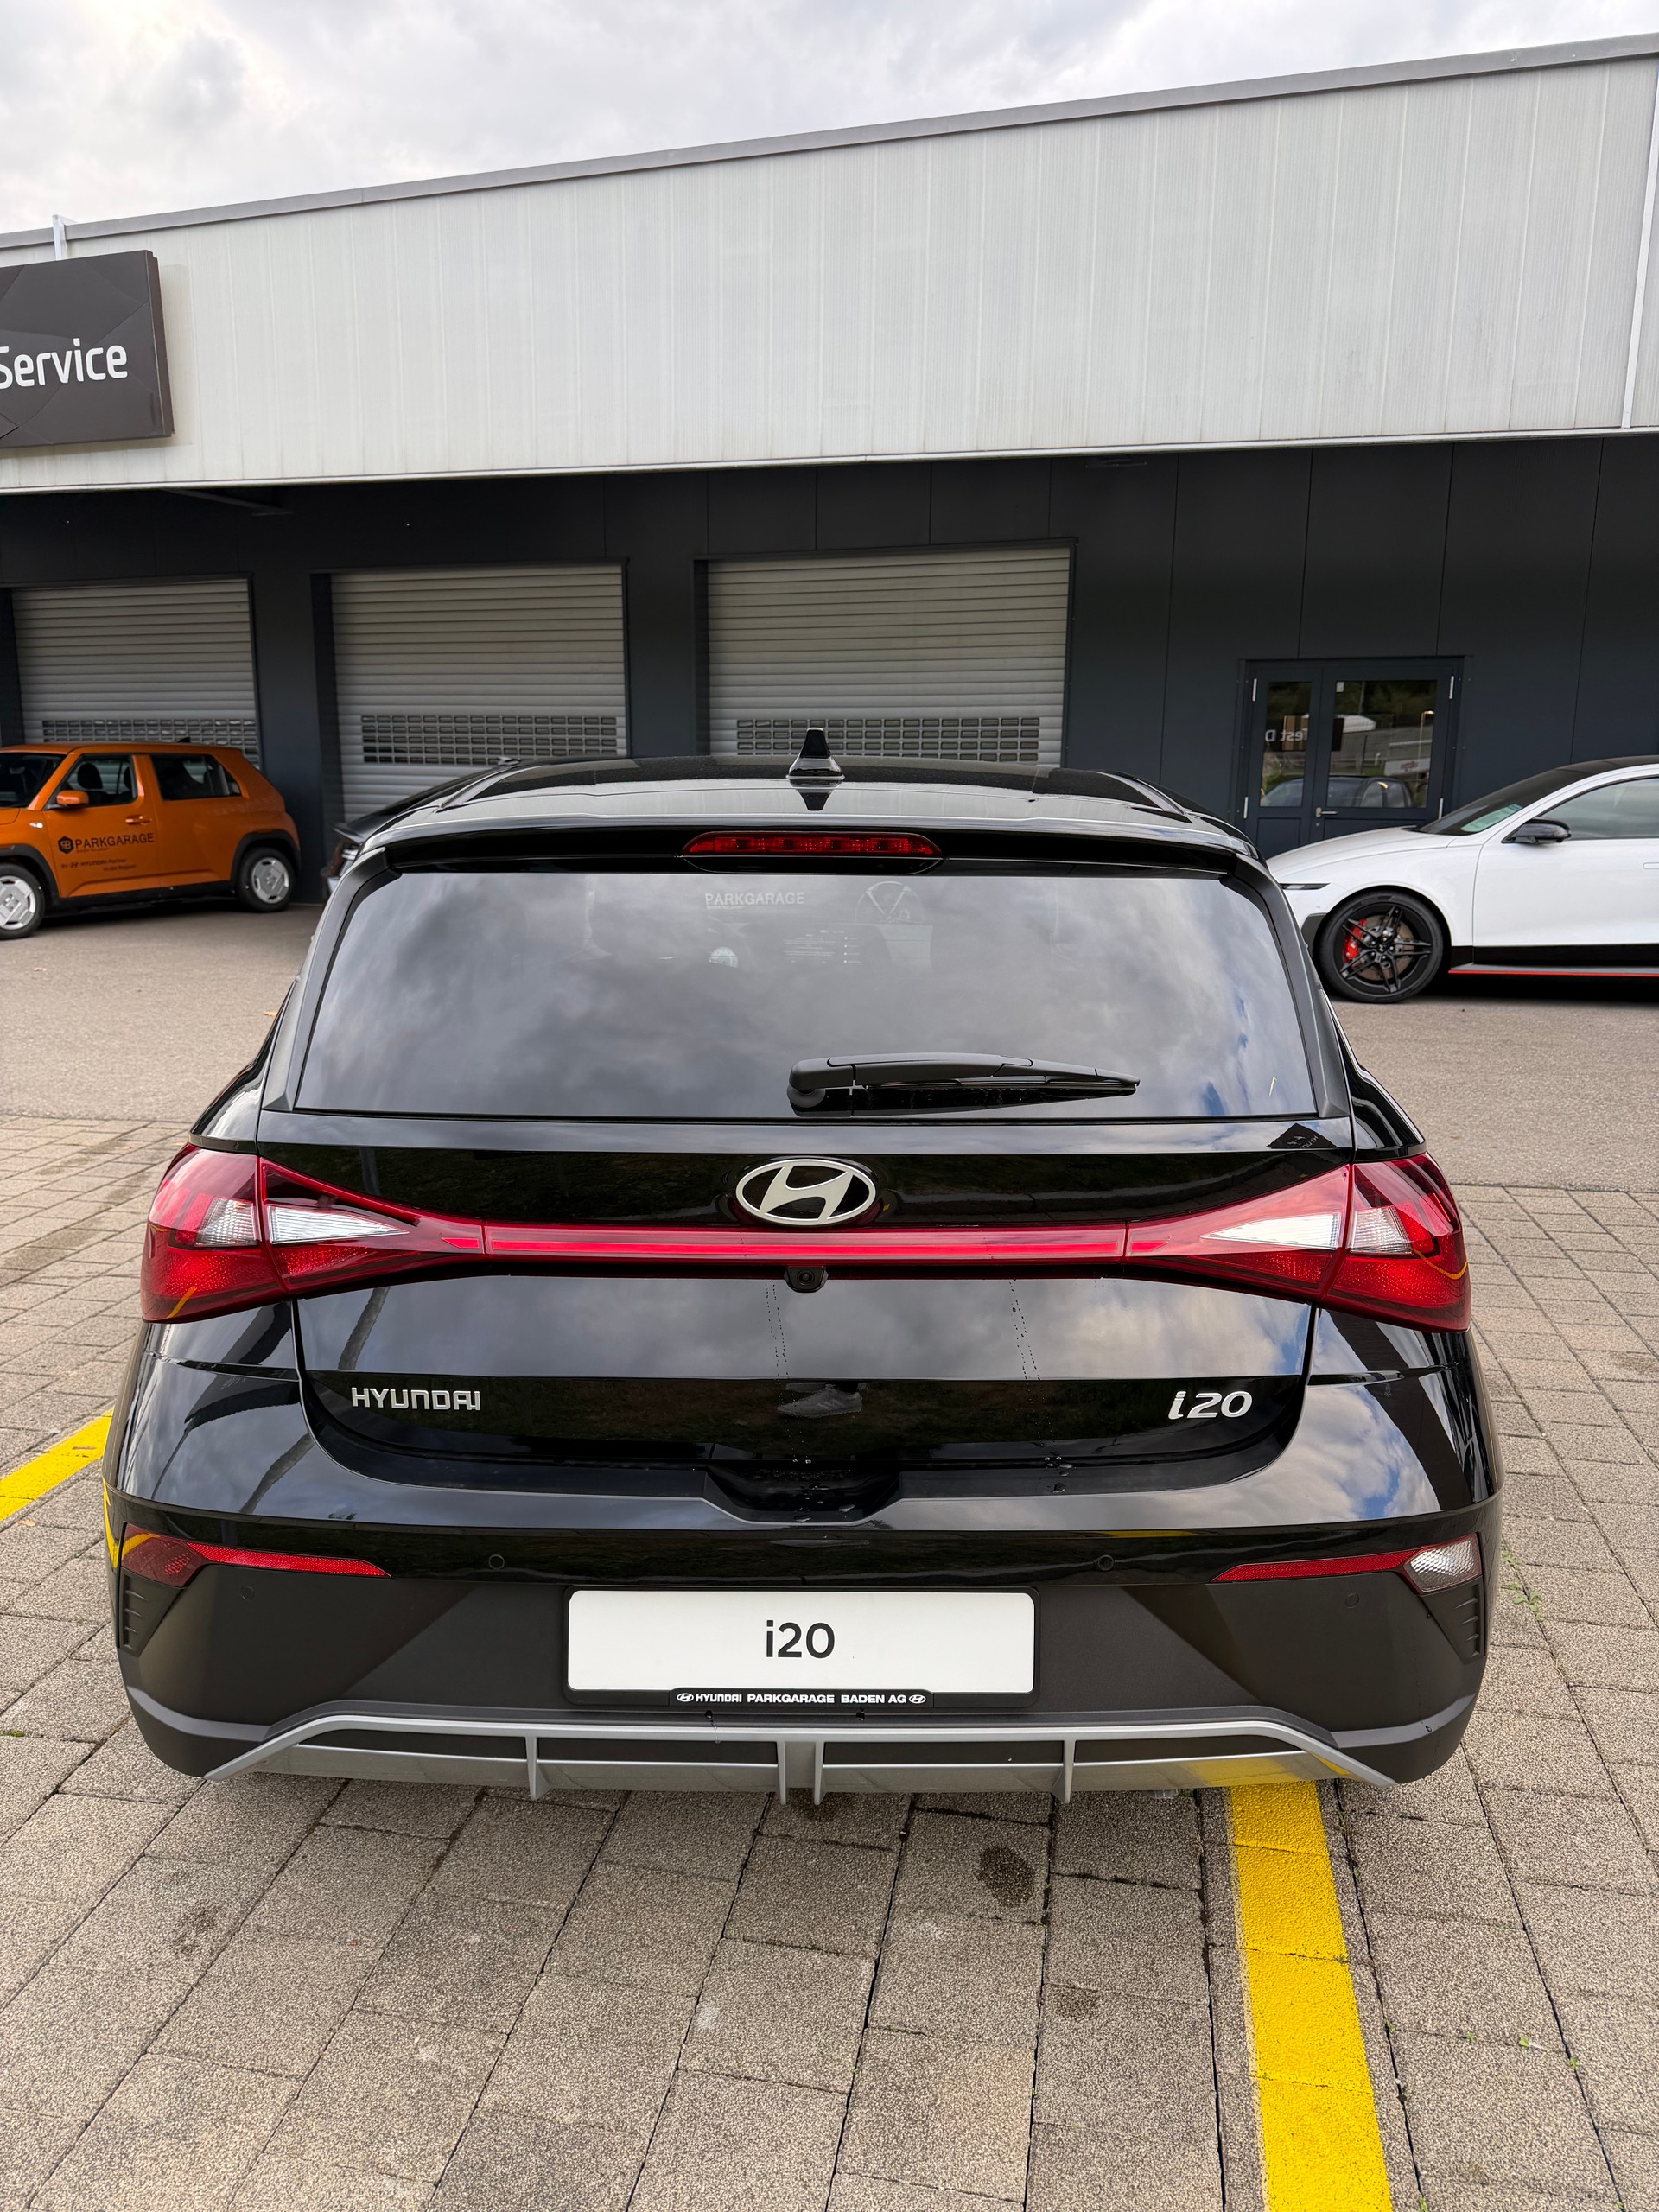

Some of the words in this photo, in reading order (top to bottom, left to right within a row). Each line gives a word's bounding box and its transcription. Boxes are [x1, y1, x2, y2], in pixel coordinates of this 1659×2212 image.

[0, 338, 128, 389] Service
[75, 833, 155, 849] PARKGARAGE
[705, 892, 805, 906] PARKGARAGE
[351, 1387, 481, 1411] HYUNDAI
[1168, 1390, 1253, 1420] i20
[766, 1619, 835, 1659] i20
[696, 1693, 742, 1702] HYUNDAI
[747, 1694, 835, 1704] PARKGARAGE
[841, 1694, 887, 1704] BADEN
[887, 1694, 907, 1704] AG
